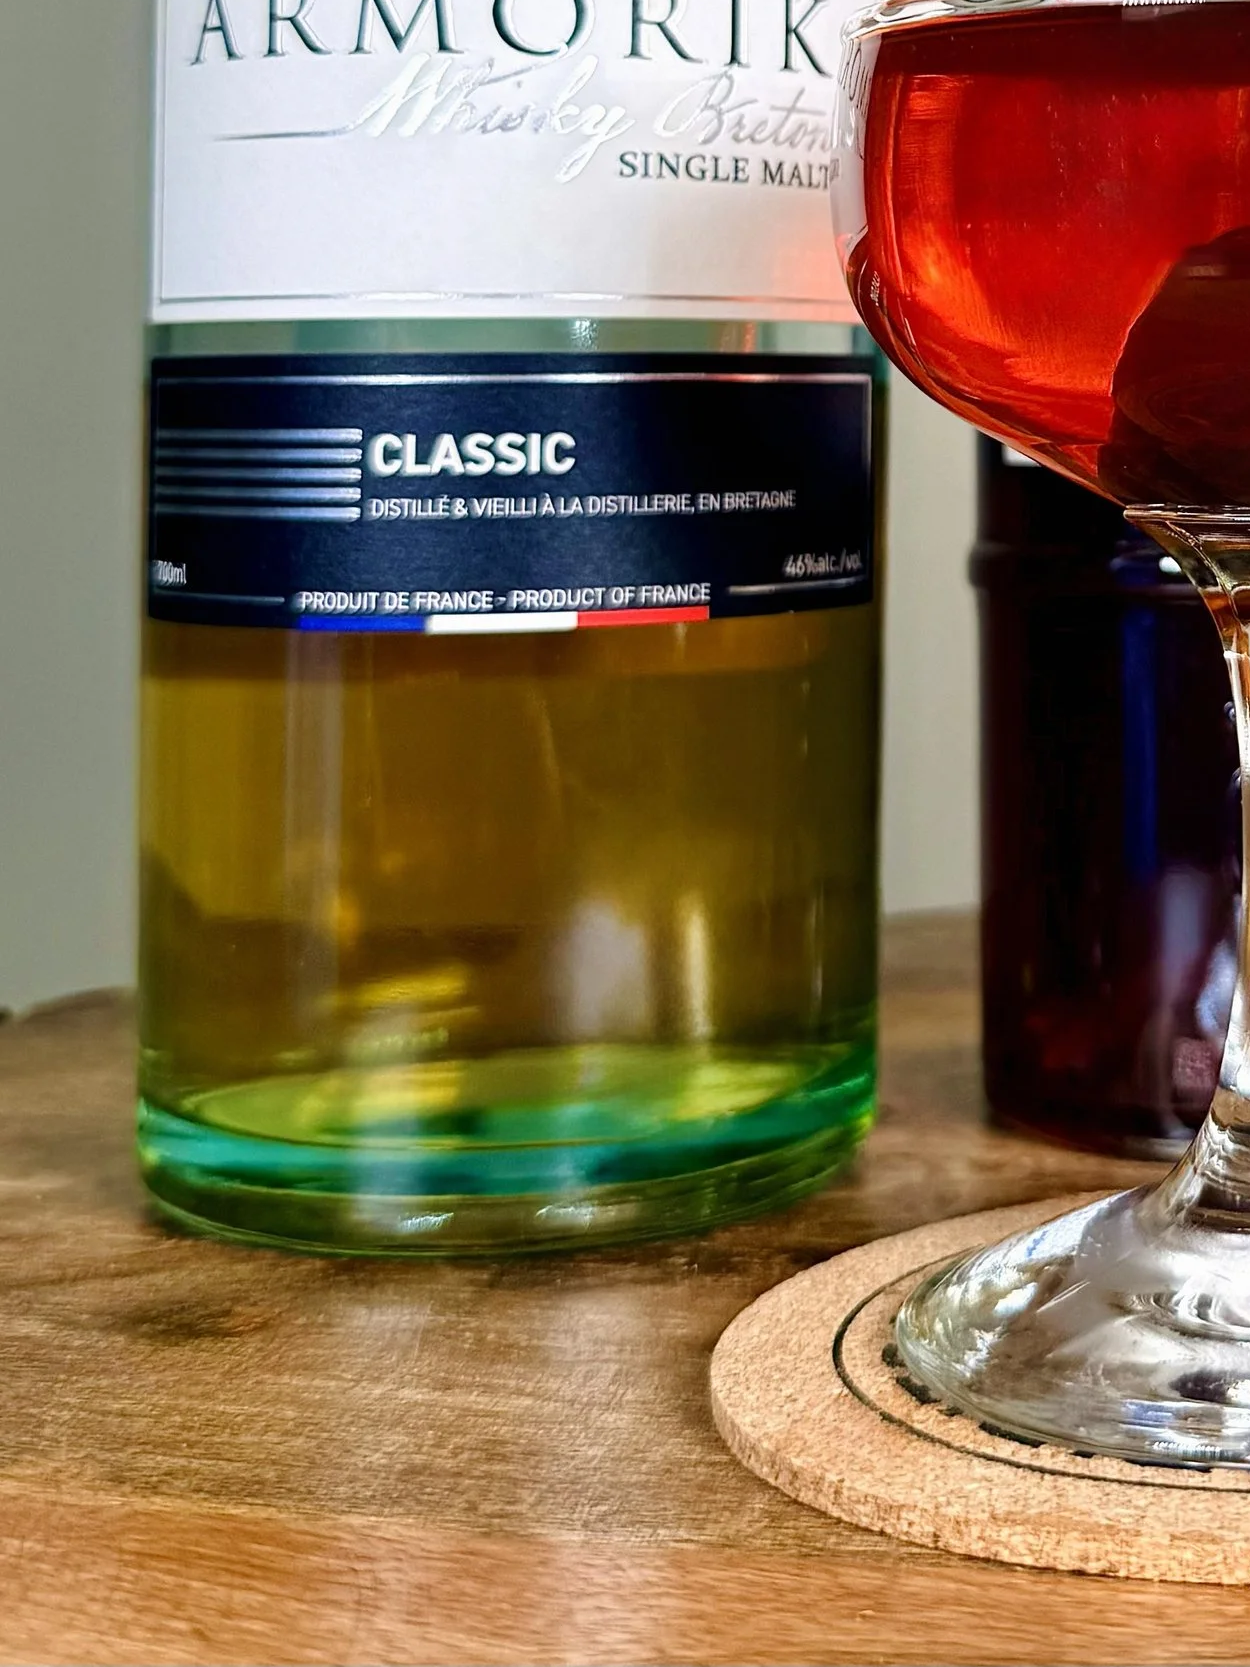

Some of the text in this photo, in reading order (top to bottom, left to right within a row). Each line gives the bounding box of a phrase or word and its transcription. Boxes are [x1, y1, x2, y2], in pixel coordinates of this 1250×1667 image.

[619, 150, 833, 192] SINGLE MALT
[370, 431, 578, 478] CLASSIC
[368, 492, 451, 520] DISTILLÉ
[453, 498, 470, 519] &
[473, 496, 538, 520] VIEILLI
[541, 490, 557, 518] À
[559, 497, 585, 518] LA
[698, 491, 722, 512] EN
[723, 488, 798, 514] BRETAGNE
[299, 589, 378, 616] PRODUIT
[384, 590, 410, 613] DE
[413, 589, 495, 614] FRANCE
[511, 587, 606, 612] PRODUCT
[610, 584, 638, 608] OF
[640, 582, 711, 606] FRANCE
